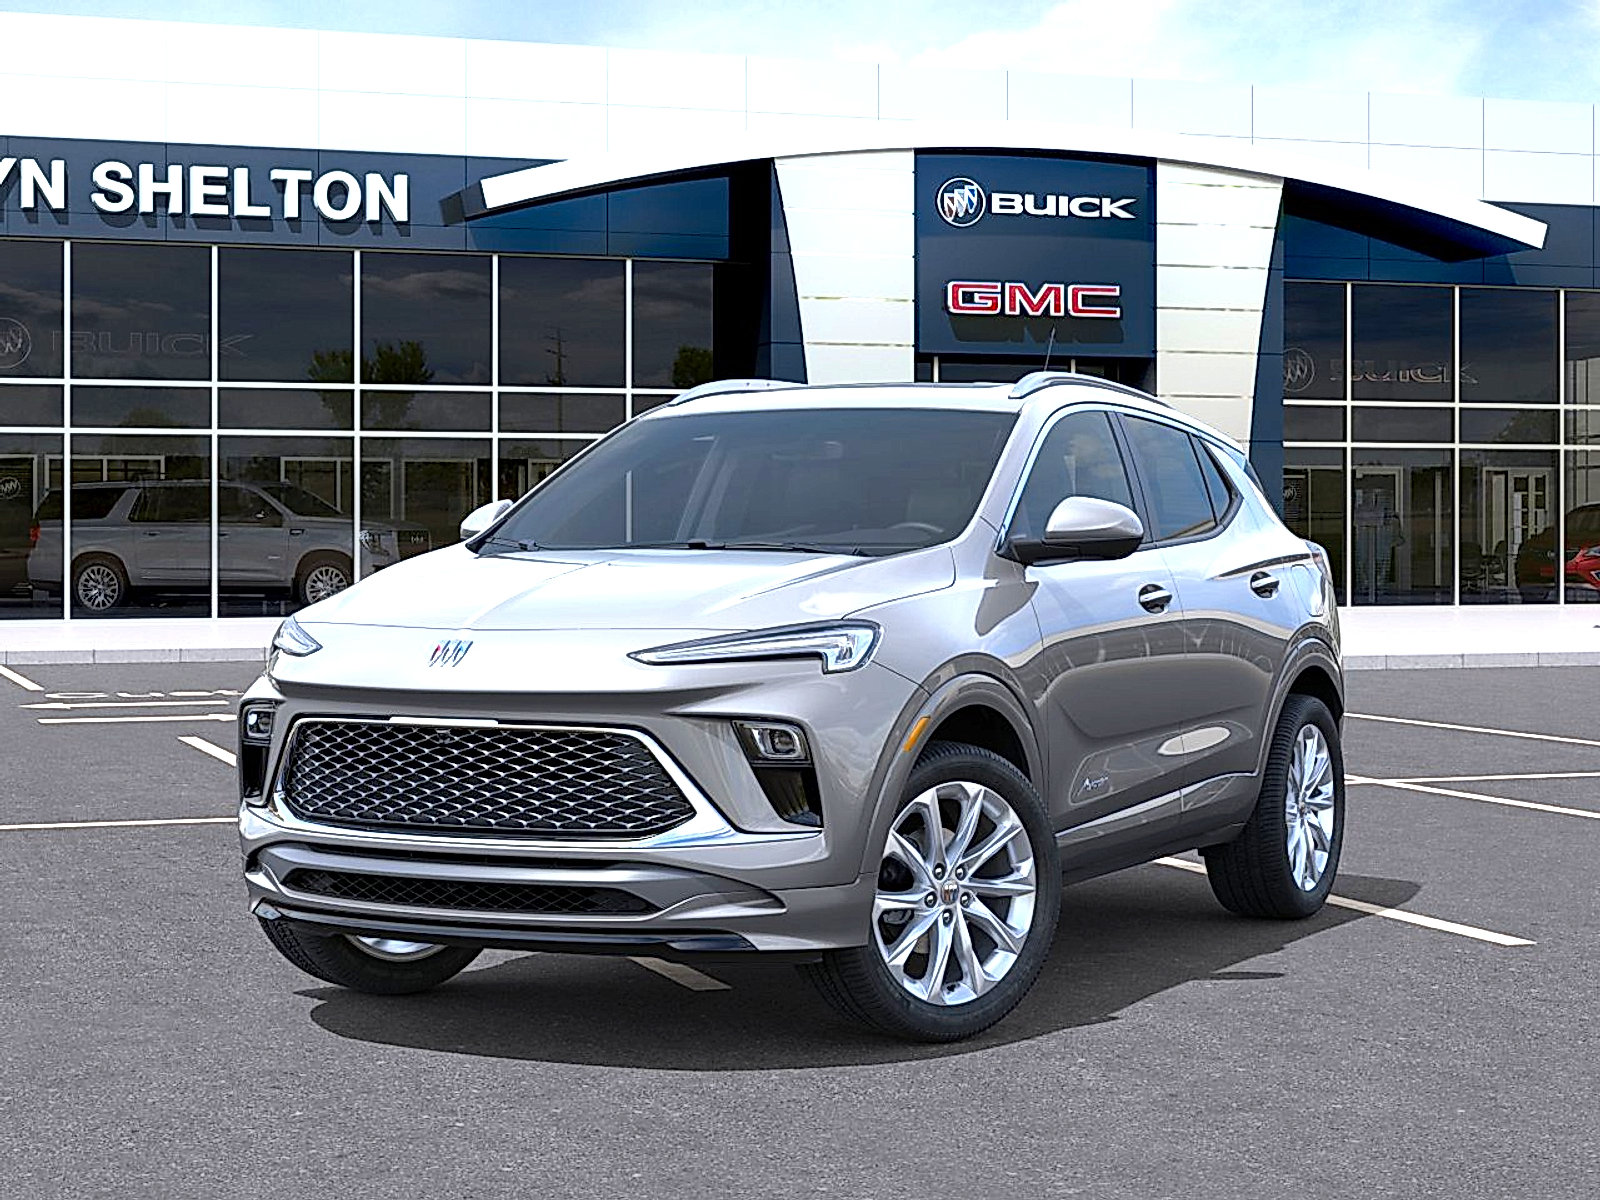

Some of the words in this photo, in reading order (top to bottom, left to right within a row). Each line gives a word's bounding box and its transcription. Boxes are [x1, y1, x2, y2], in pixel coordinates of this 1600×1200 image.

[91, 161, 409, 222] SHELTON
[991, 193, 1137, 219] BUICK
[947, 281, 1121, 318] GMC
[53, 330, 254, 356] BUICK
